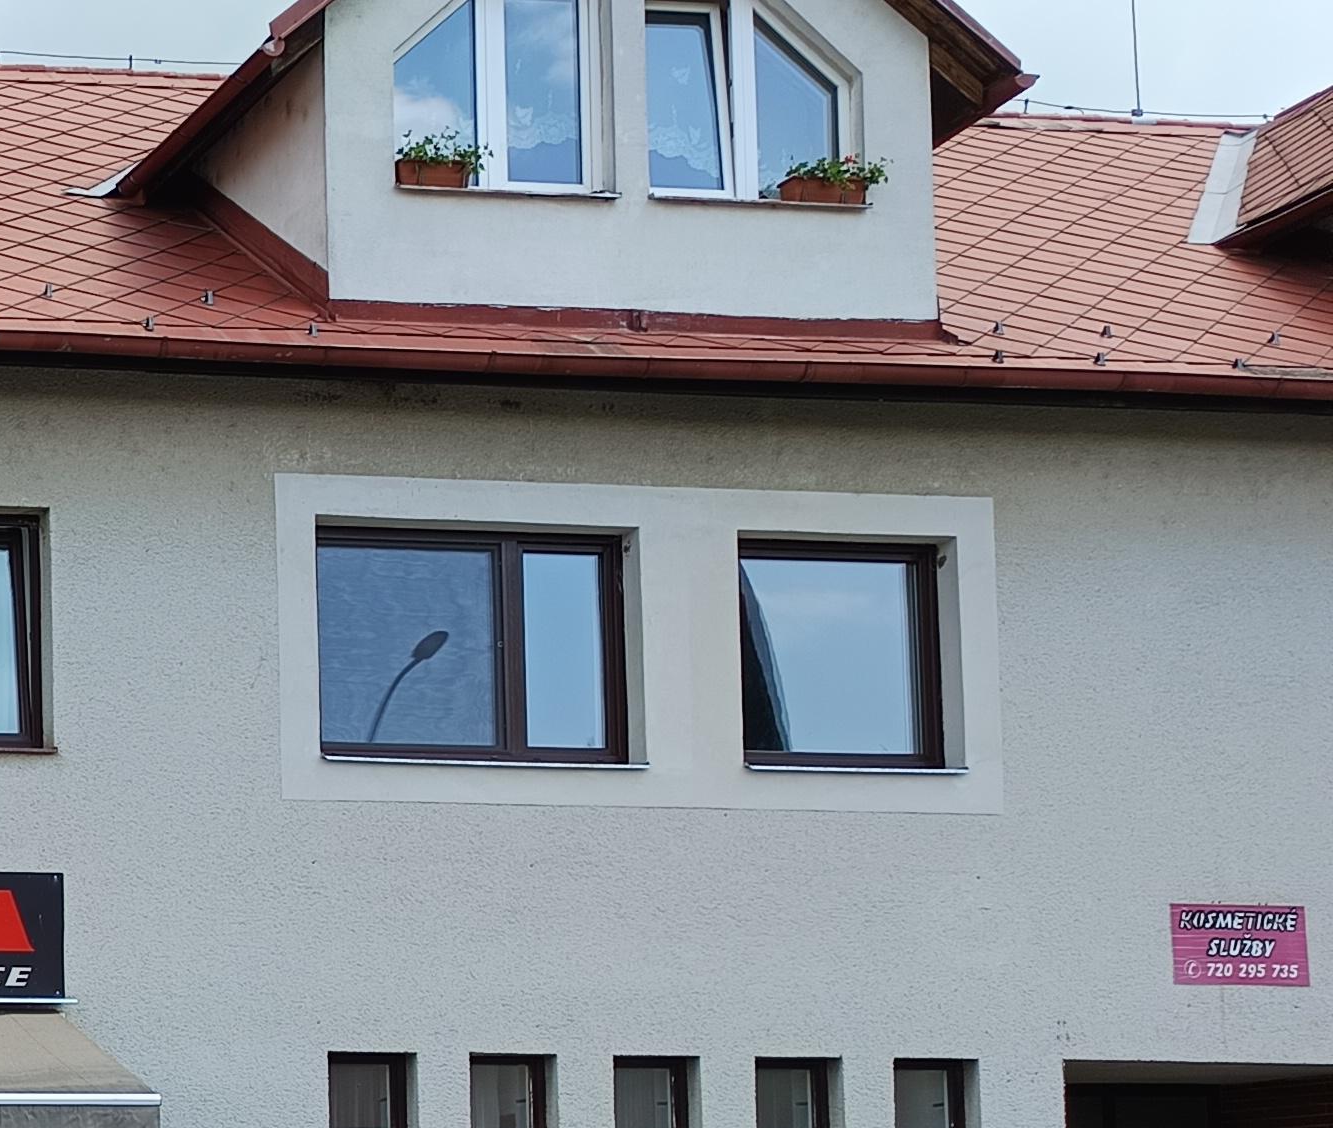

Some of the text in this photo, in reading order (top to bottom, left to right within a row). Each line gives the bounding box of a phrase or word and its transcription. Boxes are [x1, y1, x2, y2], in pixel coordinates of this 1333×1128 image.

[1179, 907, 1299, 932] KOSMETICKÉ
[1207, 934, 1276, 958] SLUŽBY
[1207, 962, 1299, 979] 720 295 735
